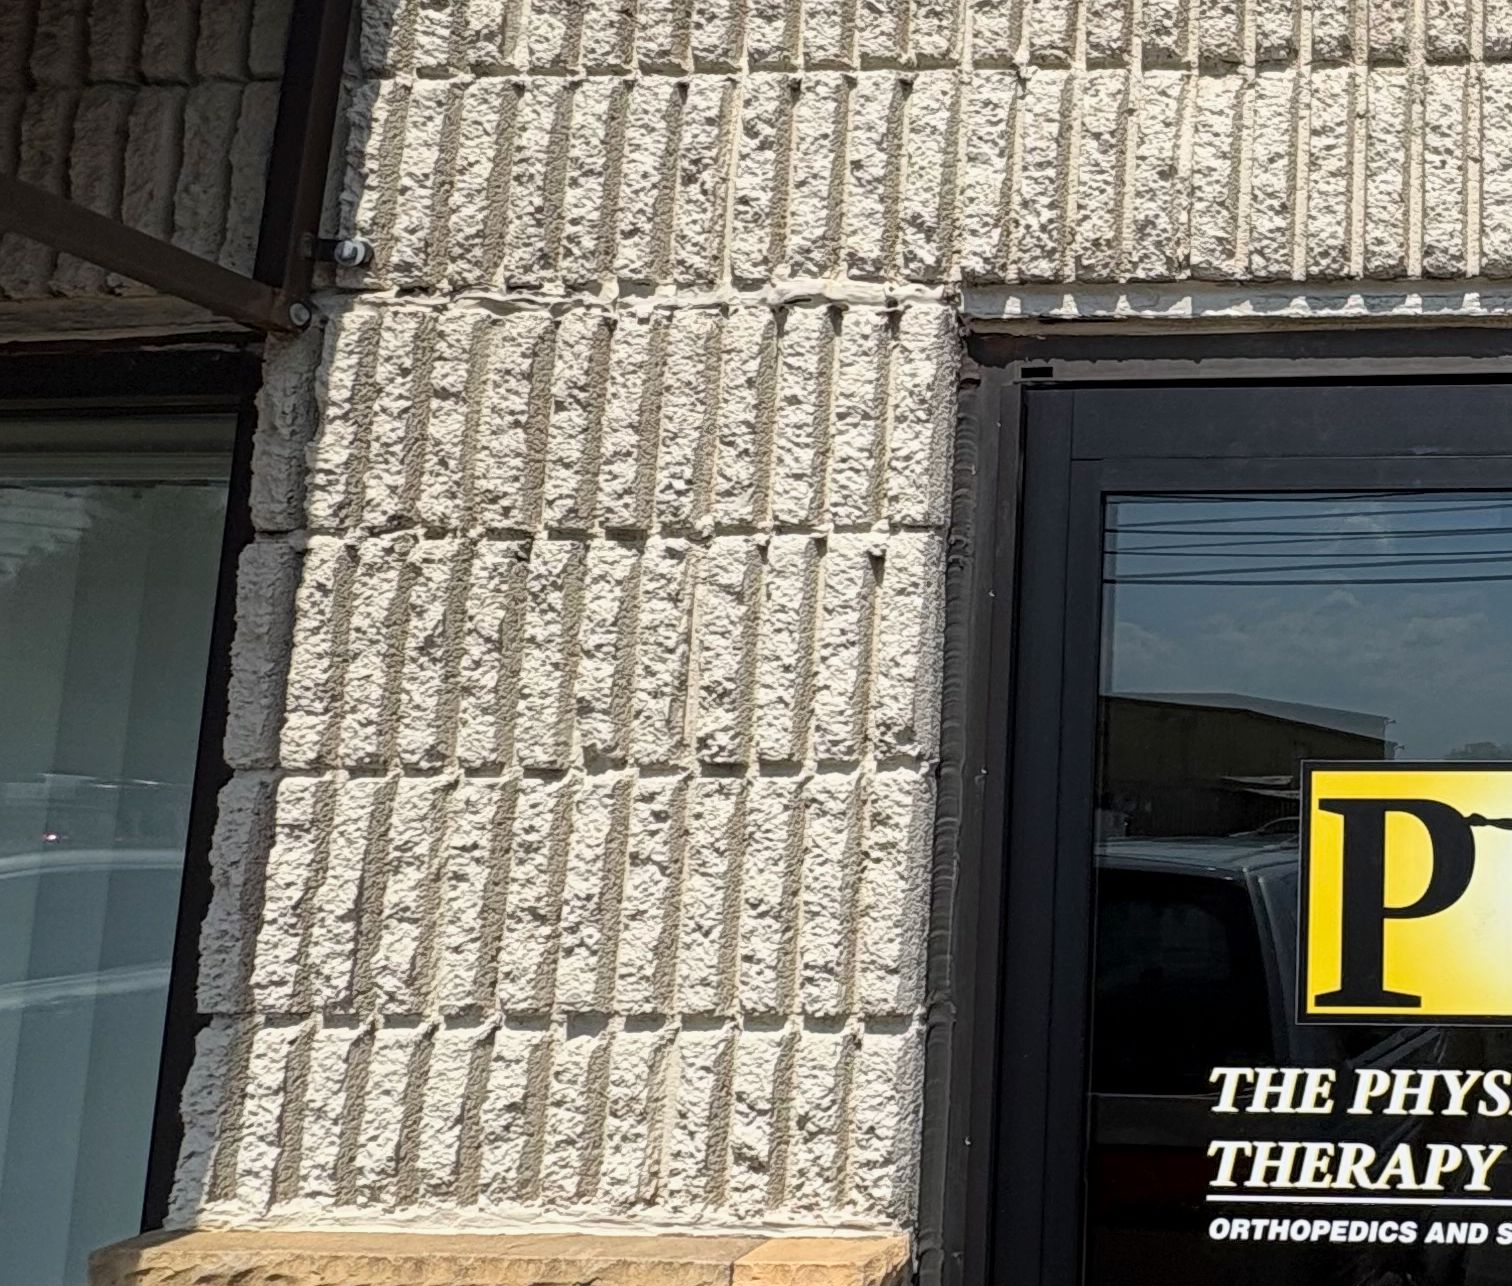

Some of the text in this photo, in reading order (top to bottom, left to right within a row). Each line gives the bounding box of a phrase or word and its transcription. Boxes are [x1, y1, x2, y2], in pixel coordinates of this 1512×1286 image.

[1208, 1066, 1337, 1115] THE
[1206, 1140, 1509, 1192] THERAPY
[1208, 1217, 1418, 1244] ORTHOPEDICS
[1424, 1221, 1489, 1245] AND
